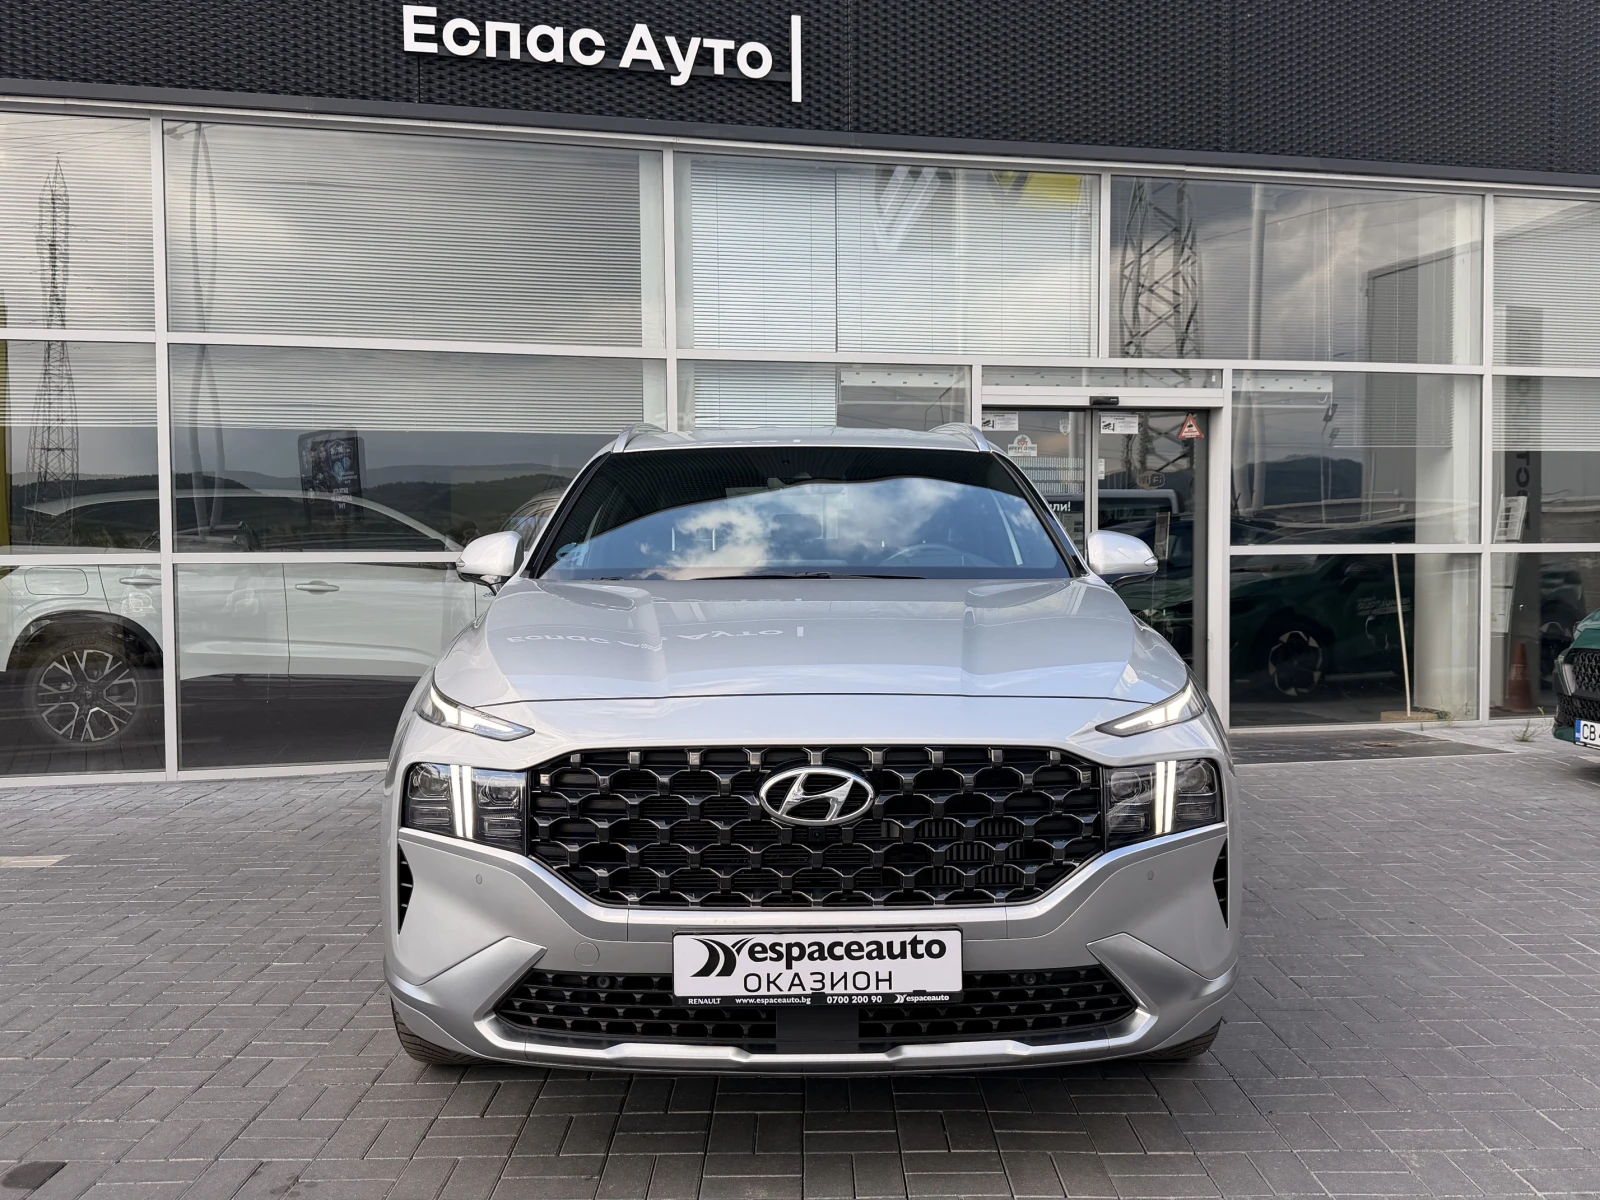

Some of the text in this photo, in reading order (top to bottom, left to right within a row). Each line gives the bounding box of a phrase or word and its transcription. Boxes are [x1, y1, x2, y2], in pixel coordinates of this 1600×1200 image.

[402, 4, 773, 86] Еспас Ауто
[748, 934, 947, 970] espaceauto
[743, 970, 893, 993] ОКАЗИОН
[735, 997, 811, 1006] www.espaceauto.bg
[826, 996, 849, 1004] 0700
[852, 996, 868, 1004] 200
[871, 995, 883, 1004] 90
[906, 994, 950, 1003] espaceauto
